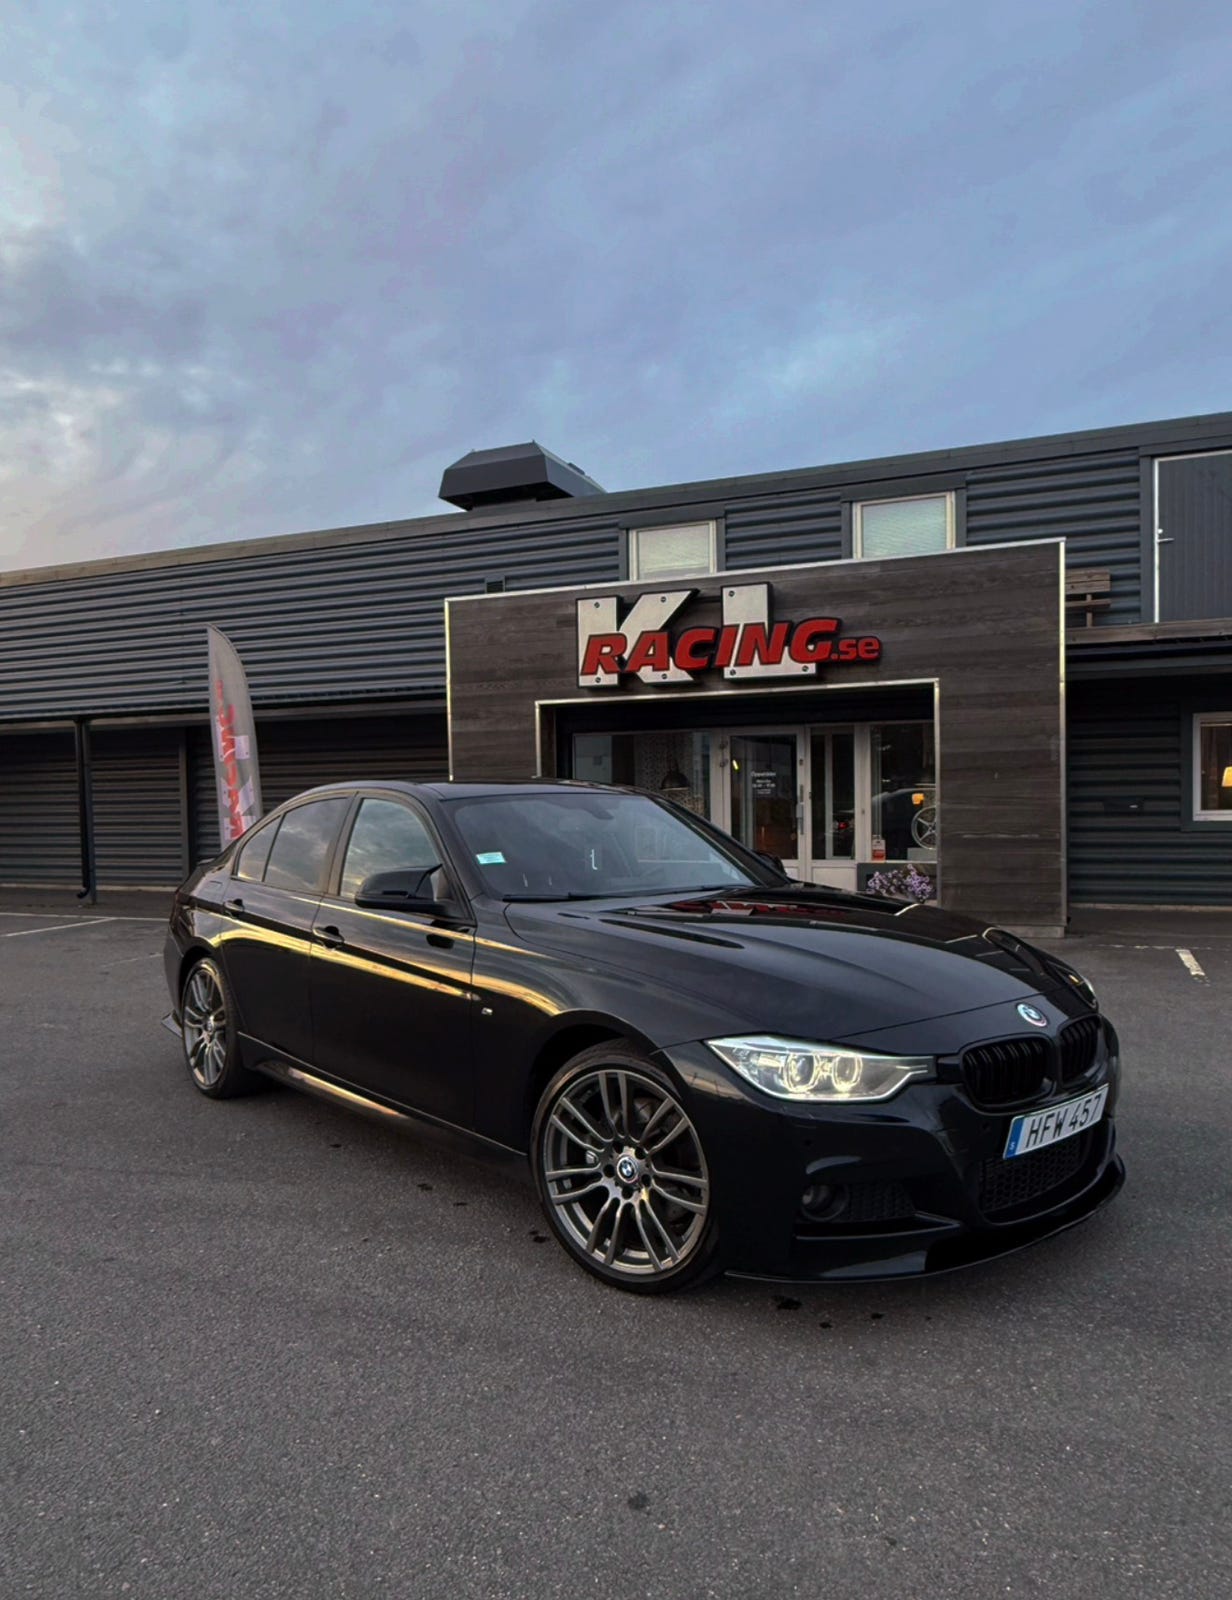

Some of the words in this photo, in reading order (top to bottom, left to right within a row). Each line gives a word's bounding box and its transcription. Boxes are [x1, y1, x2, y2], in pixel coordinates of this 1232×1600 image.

[577, 583, 817, 688] KL
[1025, 1107, 1069, 1148] HFW
[1068, 1093, 1102, 1131] 457
